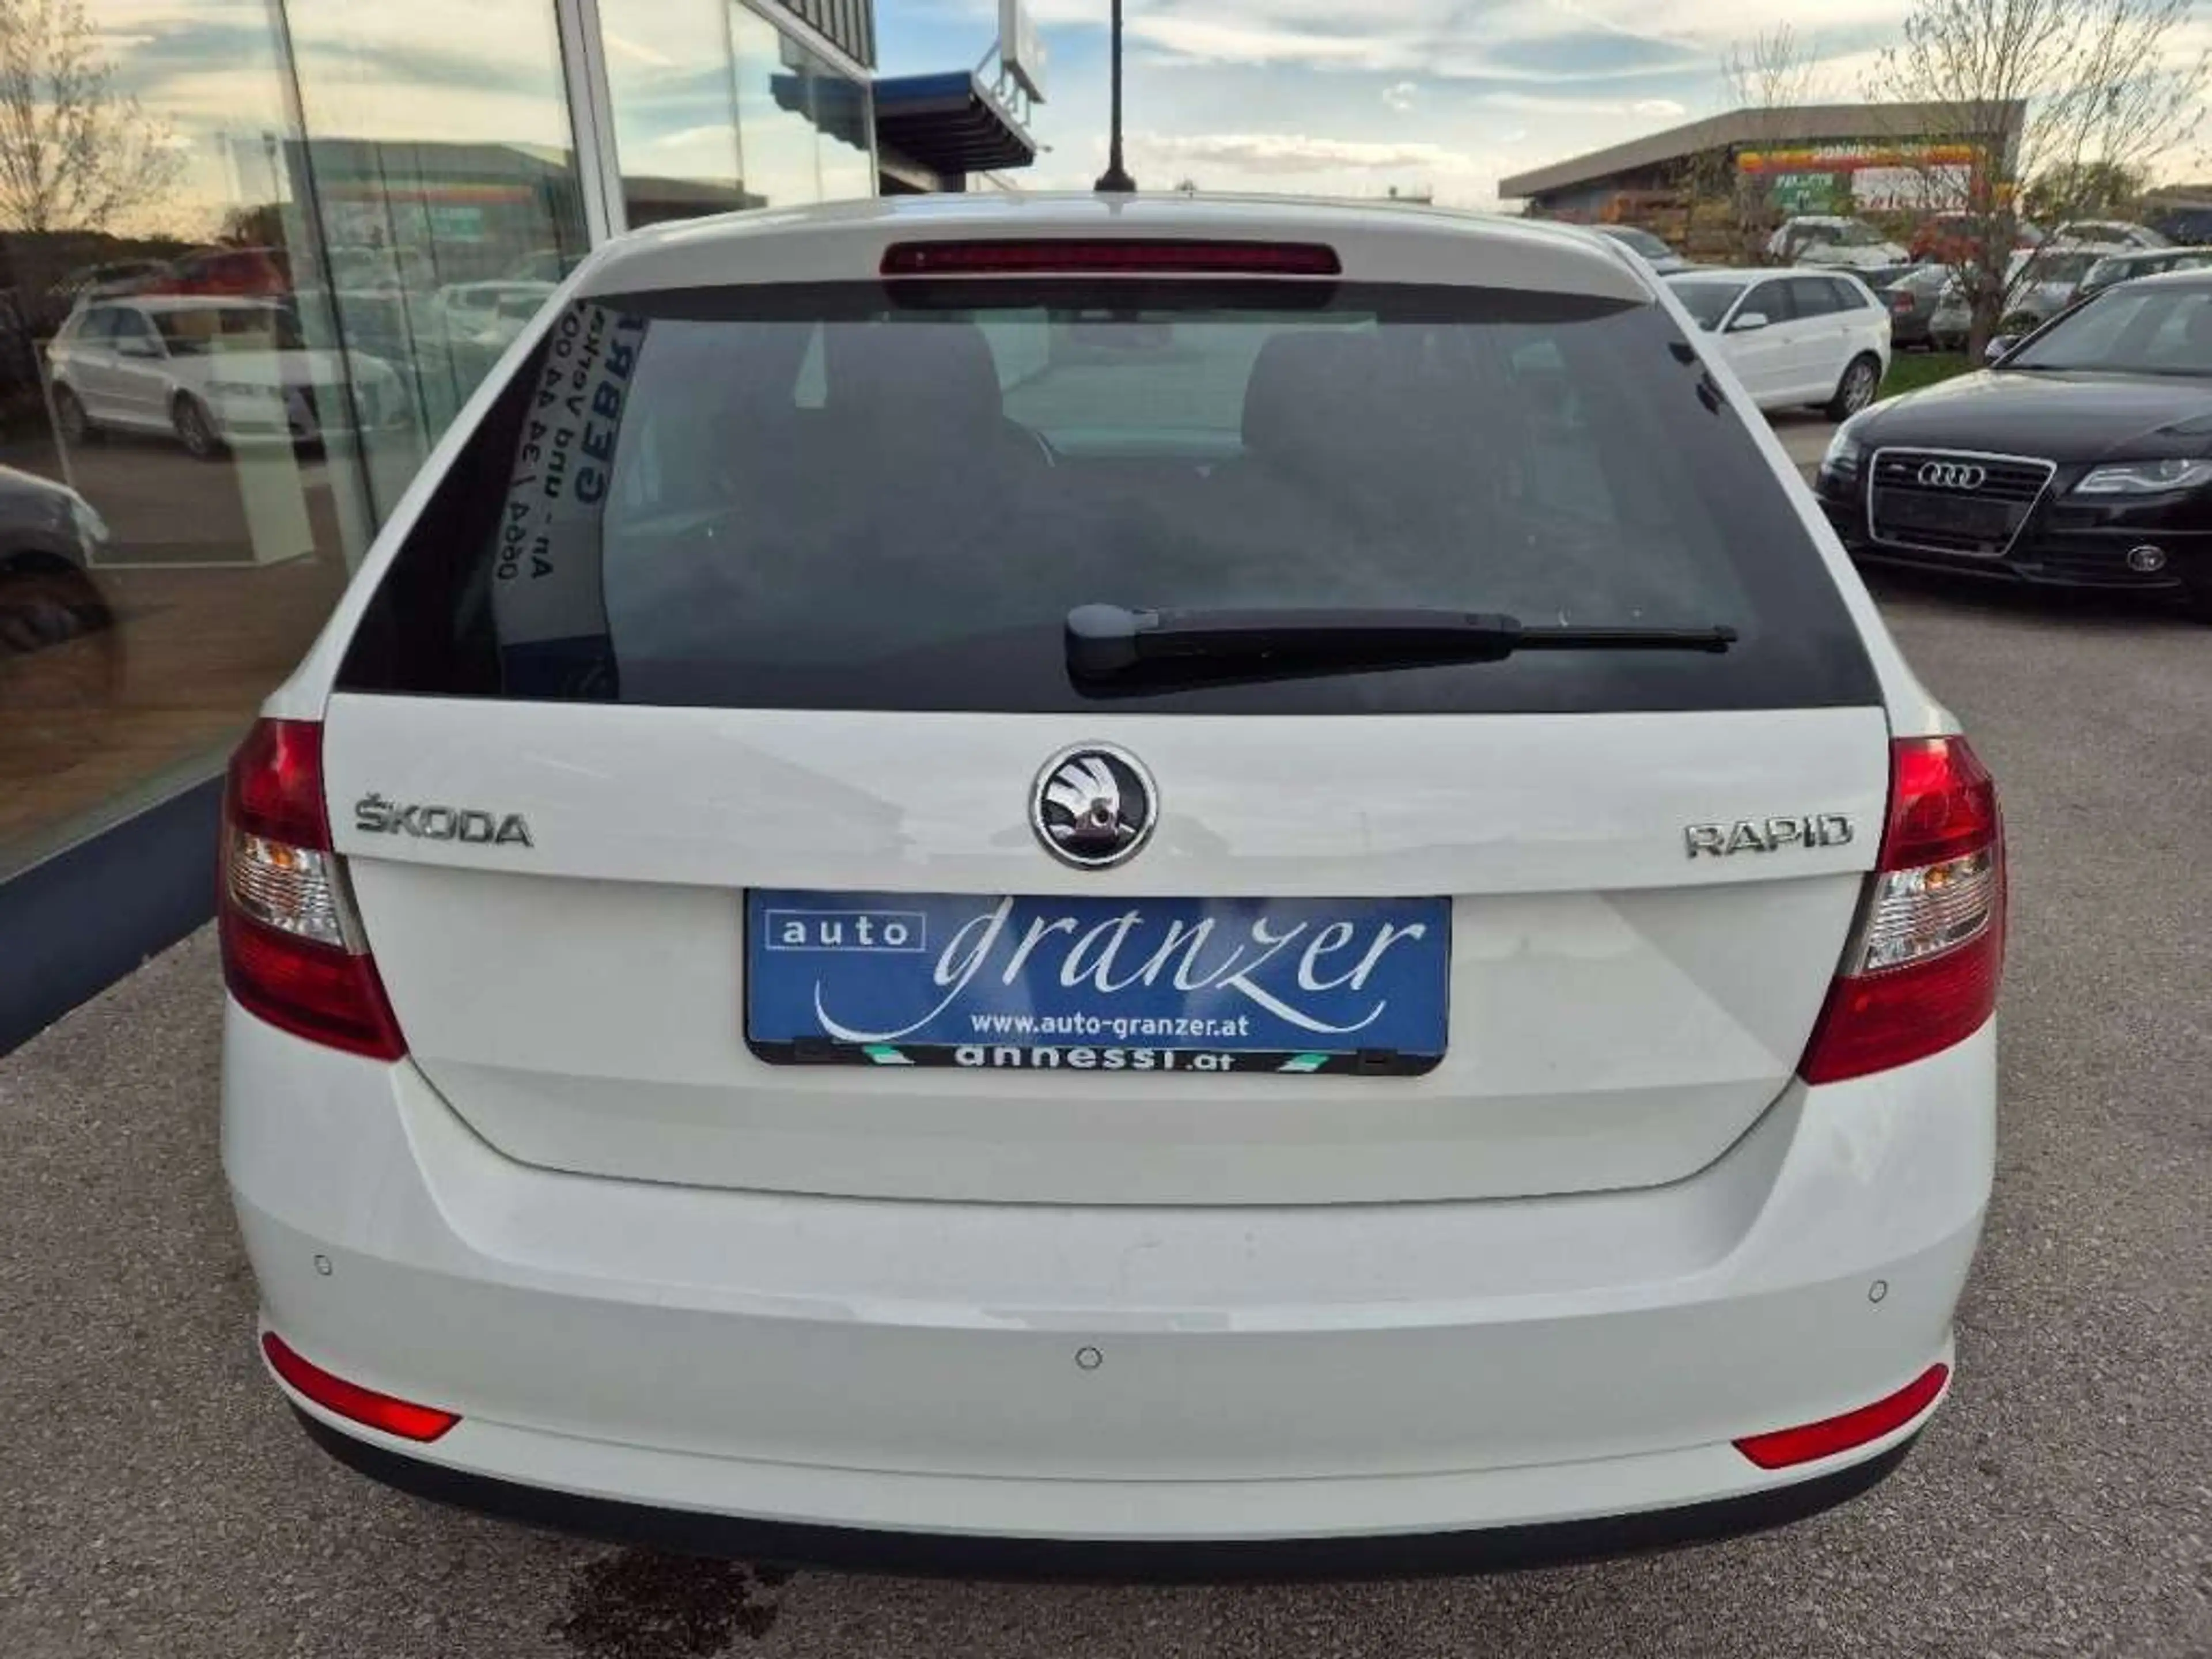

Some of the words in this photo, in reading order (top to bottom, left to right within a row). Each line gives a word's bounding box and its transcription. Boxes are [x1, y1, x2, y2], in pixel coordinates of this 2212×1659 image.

[354, 791, 535, 847] ŠKODA
[1684, 813, 1854, 858] RAPID
[782, 915, 909, 946] auto
[814, 895, 1426, 1041] granzer
[971, 1012, 1249, 1039] www.auto-granzer.at
